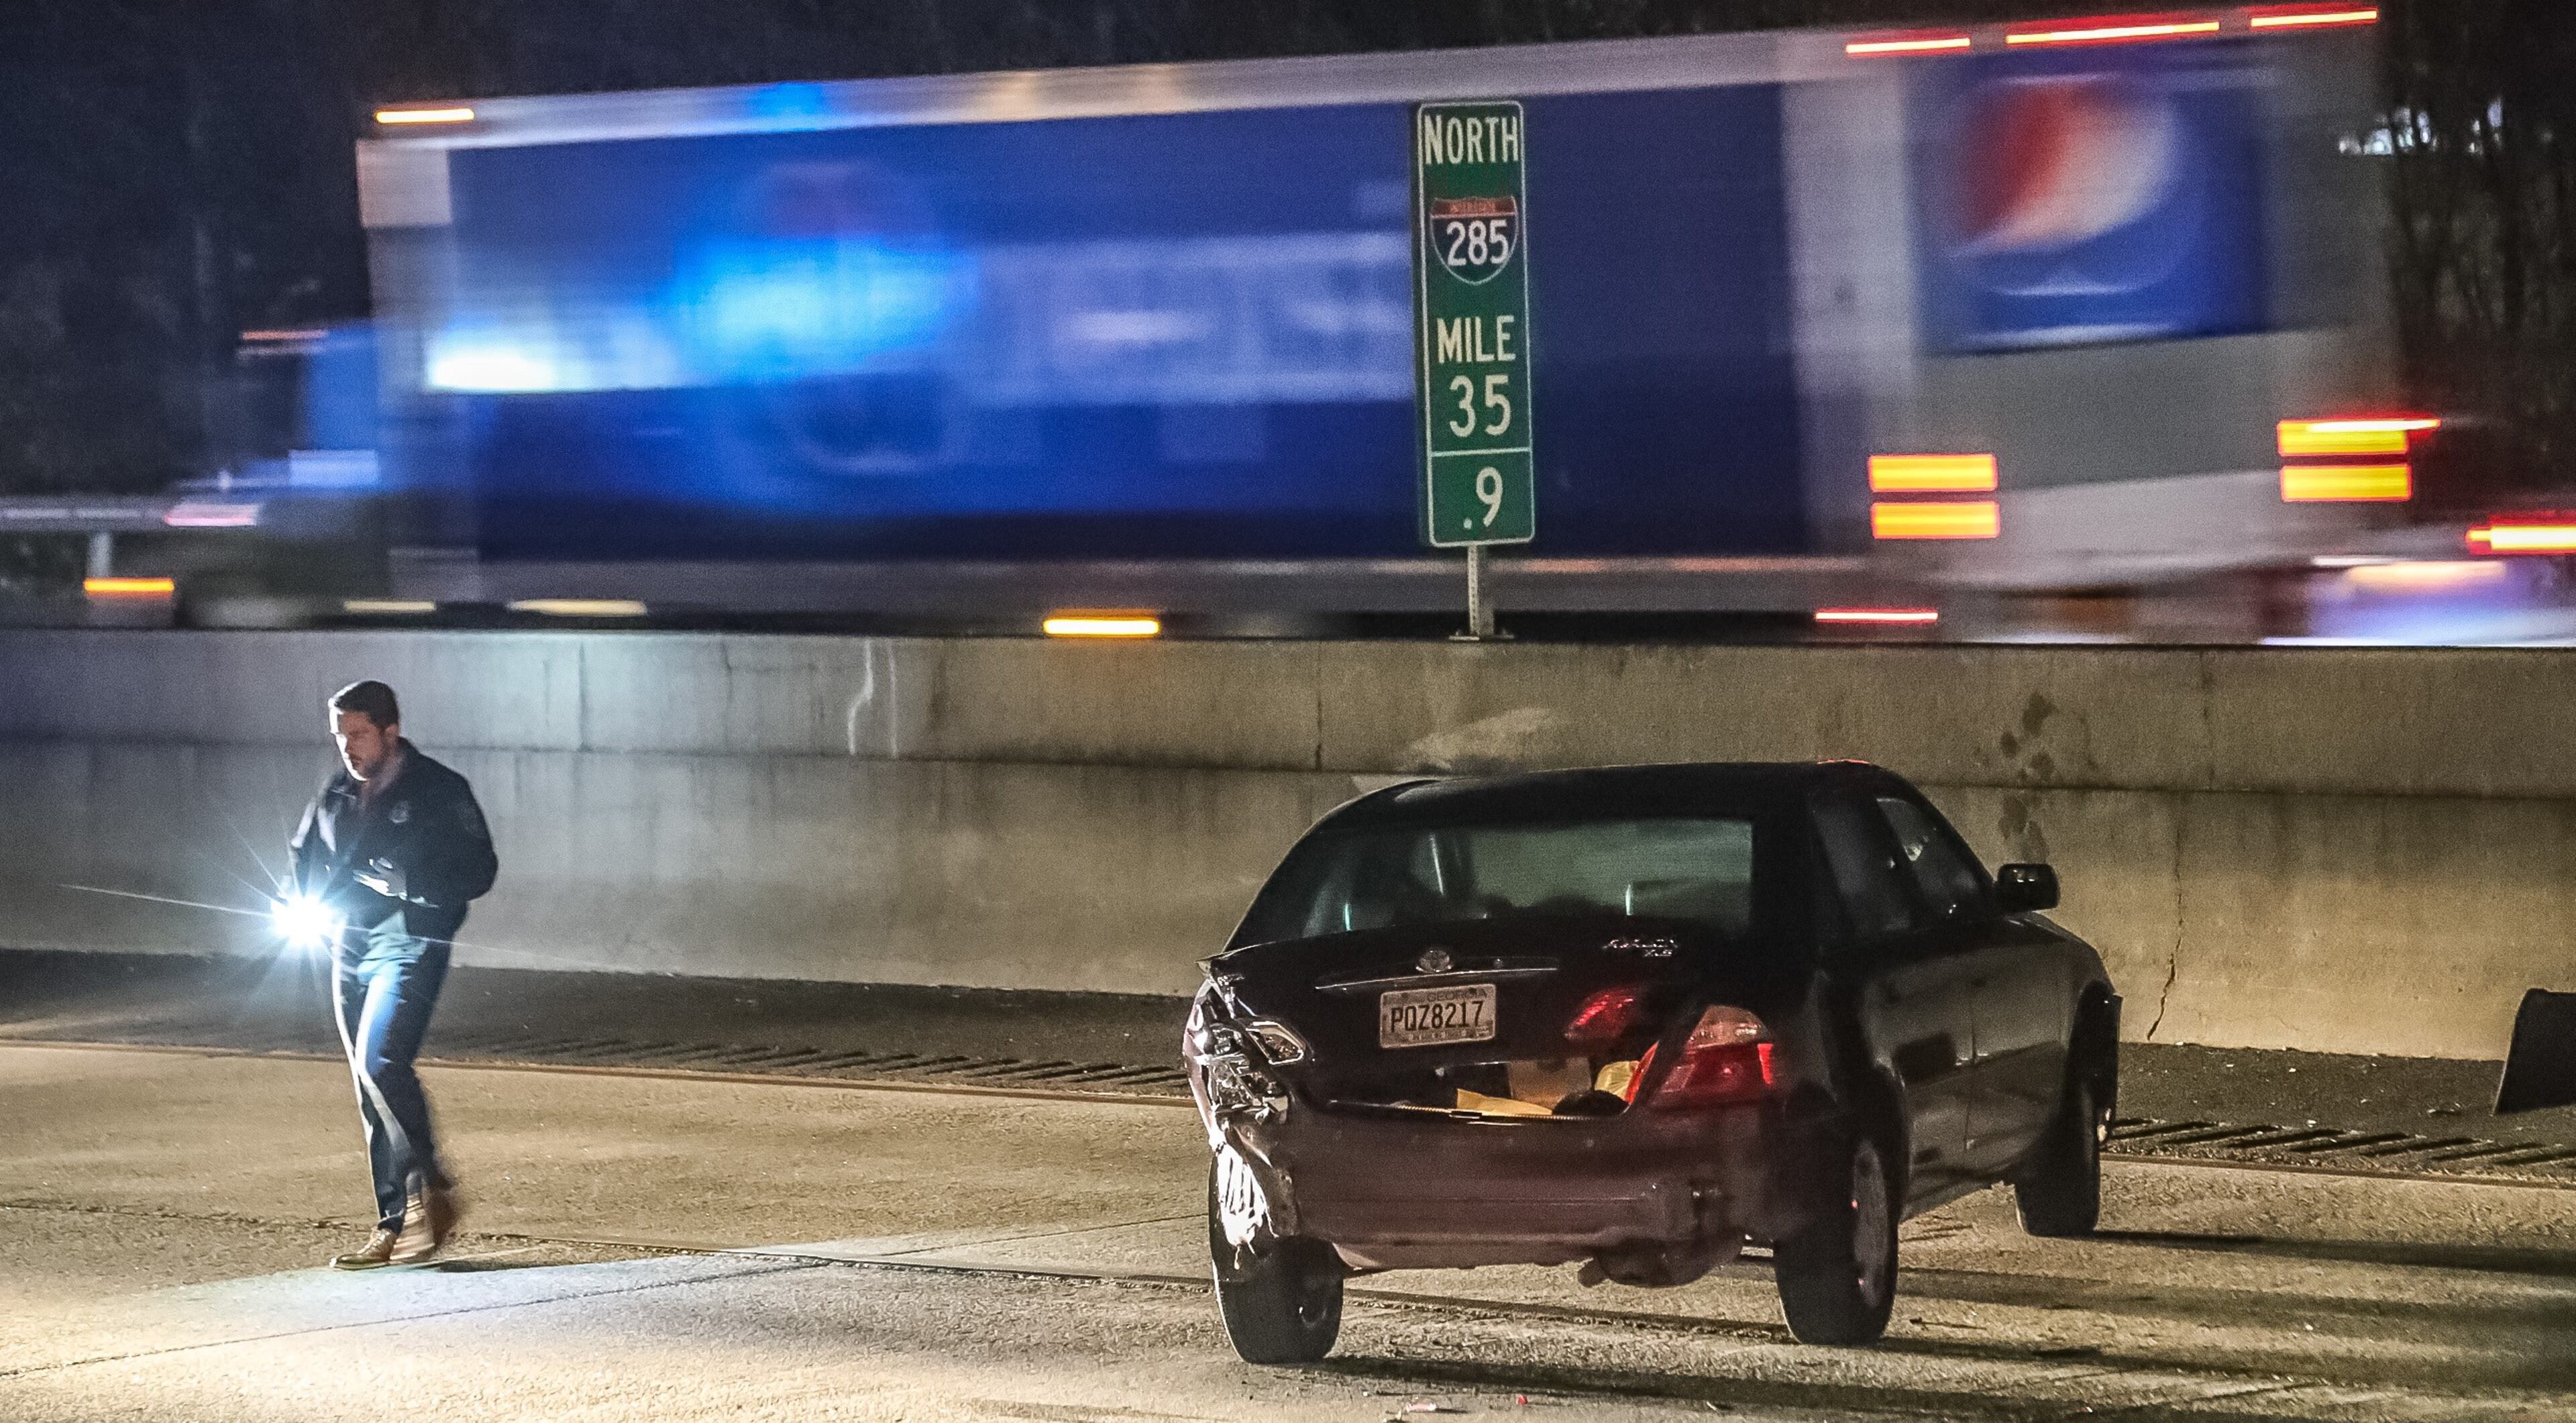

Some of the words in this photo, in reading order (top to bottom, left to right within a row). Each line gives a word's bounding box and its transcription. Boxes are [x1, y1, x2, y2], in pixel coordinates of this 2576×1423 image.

[1424, 115, 1519, 165] NORTH
[1446, 219, 1509, 266] 285
[1436, 315, 1517, 364] MILE
[1449, 374, 1511, 437] 35
[1391, 1000, 1484, 1033] PQZ8217
